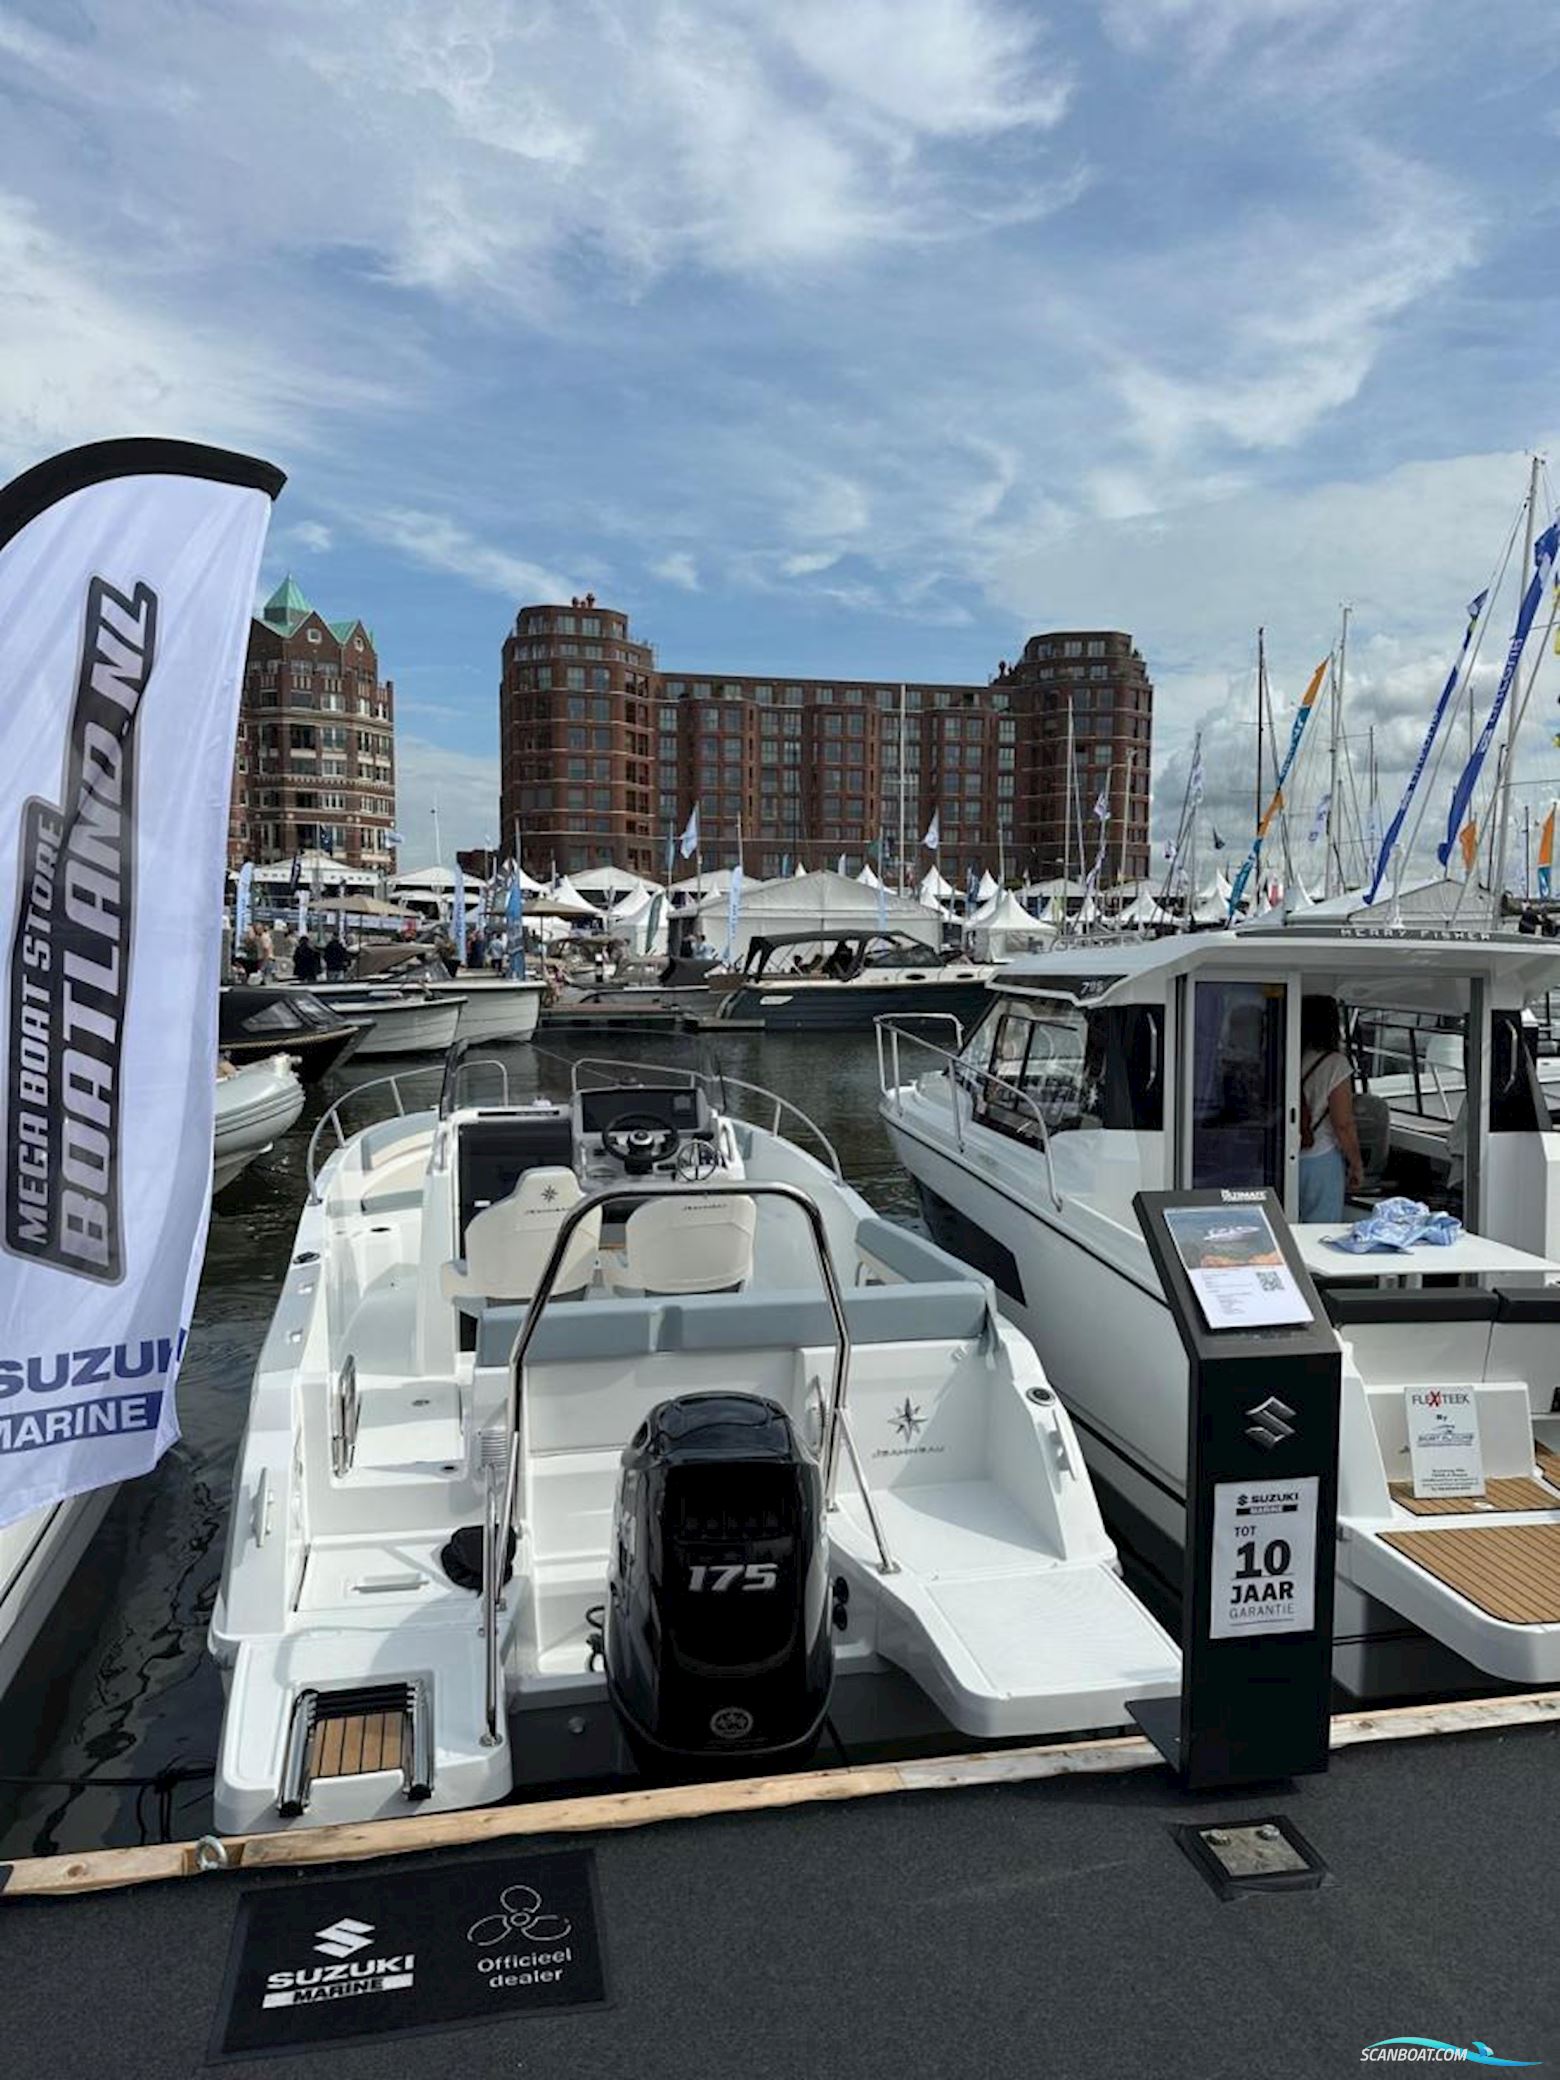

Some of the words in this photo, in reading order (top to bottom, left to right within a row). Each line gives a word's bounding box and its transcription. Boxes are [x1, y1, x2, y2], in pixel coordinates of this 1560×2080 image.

[23, 813, 63, 972] STORE
[20, 974, 50, 1107] BOAT
[18, 1111, 48, 1244] MEGA
[1251, 1492, 1299, 1503] SUZUKI
[1235, 1525, 1256, 1537] TOT
[1236, 1539, 1291, 1579] 10
[688, 1563, 778, 1592] 175
[1230, 1581, 1294, 1604] JAAR
[1229, 1603, 1295, 1619] GARANTIE
[266, 1954, 415, 1990] SUZUKI
[477, 1947, 572, 1973] Officieel
[293, 1976, 384, 2003] MARINE
[489, 1969, 563, 1988] dealer
